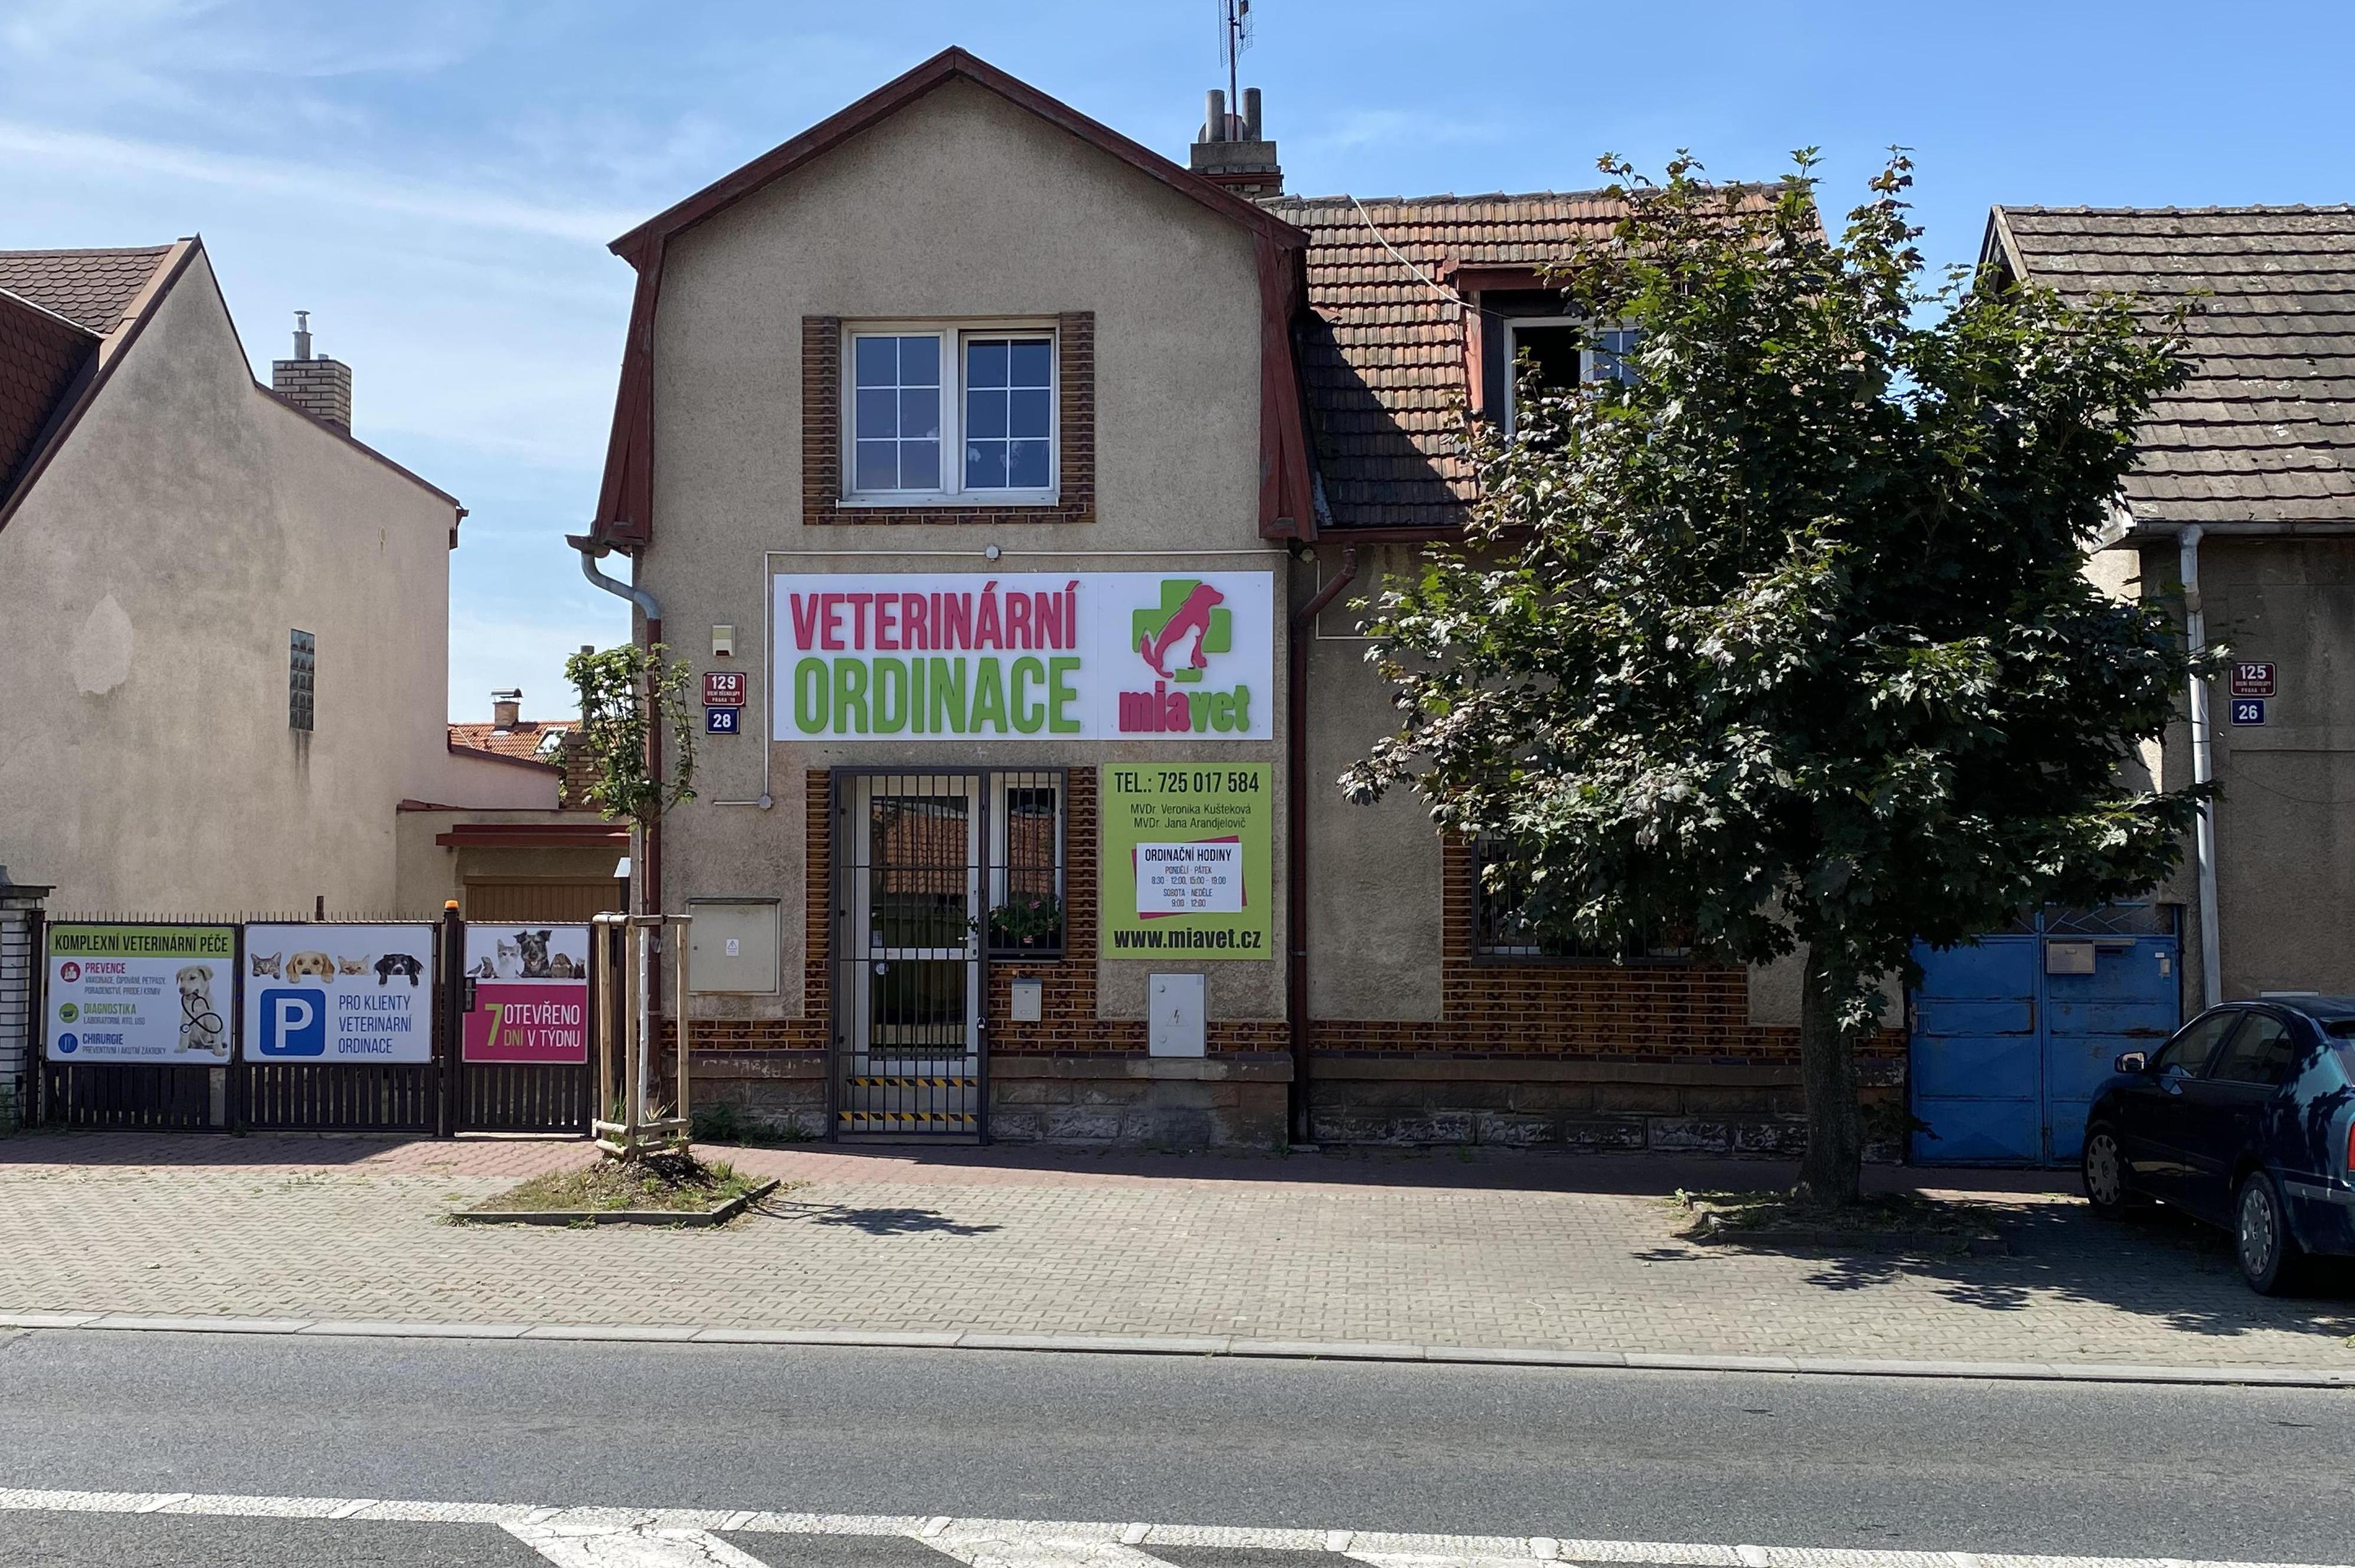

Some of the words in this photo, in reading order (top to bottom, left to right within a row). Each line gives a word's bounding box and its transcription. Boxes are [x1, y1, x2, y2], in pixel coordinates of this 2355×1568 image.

[789, 580, 1080, 650] VETERINÁRNÍ
[2240, 665, 2266, 679] 125
[712, 676, 736, 689] 129
[794, 656, 1081, 734] ORDINACE
[1119, 680, 1250, 732] miavet
[2239, 705, 2258, 719] 26
[713, 713, 731, 728] 28
[1114, 772, 1151, 793] TEL.:
[1158, 772, 1187, 793] 725
[1193, 772, 1222, 793] 017
[1228, 772, 1259, 793] 584
[1161, 803, 1201, 814] Veronika
[1203, 803, 1251, 814] Kušteková
[1165, 817, 1186, 828] Jana
[1189, 817, 1245, 830] Arandjelovič
[1145, 846, 1195, 862] ORDINAČNÍ
[1197, 849, 1232, 862] HODINY
[1194, 865, 1212, 874] PÁTEK
[1211, 876, 1226, 885] 19:00
[1163, 888, 1185, 896] SOBOTA
[1191, 888, 1212, 896] NEDĚLE
[1172, 899, 1185, 907] 9:00
[1190, 899, 1206, 907] 12:00
[55, 932, 119, 950] KOMPLEXNÍ
[123, 932, 197, 951] VETERINÁRNÍ
[200, 934, 228, 952] PÉČE
[1114, 927, 1261, 948] www.miavet.cz
[85, 963, 126, 974] PREVENCE
[84, 1003, 136, 1014] DIAGNOSTIKA
[339, 995, 361, 1010] PRO
[364, 995, 411, 1010] KLIENTY
[504, 1000, 580, 1025] OTEVŘENO
[275, 998, 313, 1048] P
[339, 1014, 412, 1032] VETERINÁRNÍ
[485, 1003, 503, 1046] 7
[83, 1033, 123, 1045] CHIRURGIE
[504, 1027, 524, 1046] DNÍ
[527, 1030, 536, 1046] V
[539, 1026, 580, 1047] TÝDNU
[338, 1037, 392, 1053] ORDINACE
